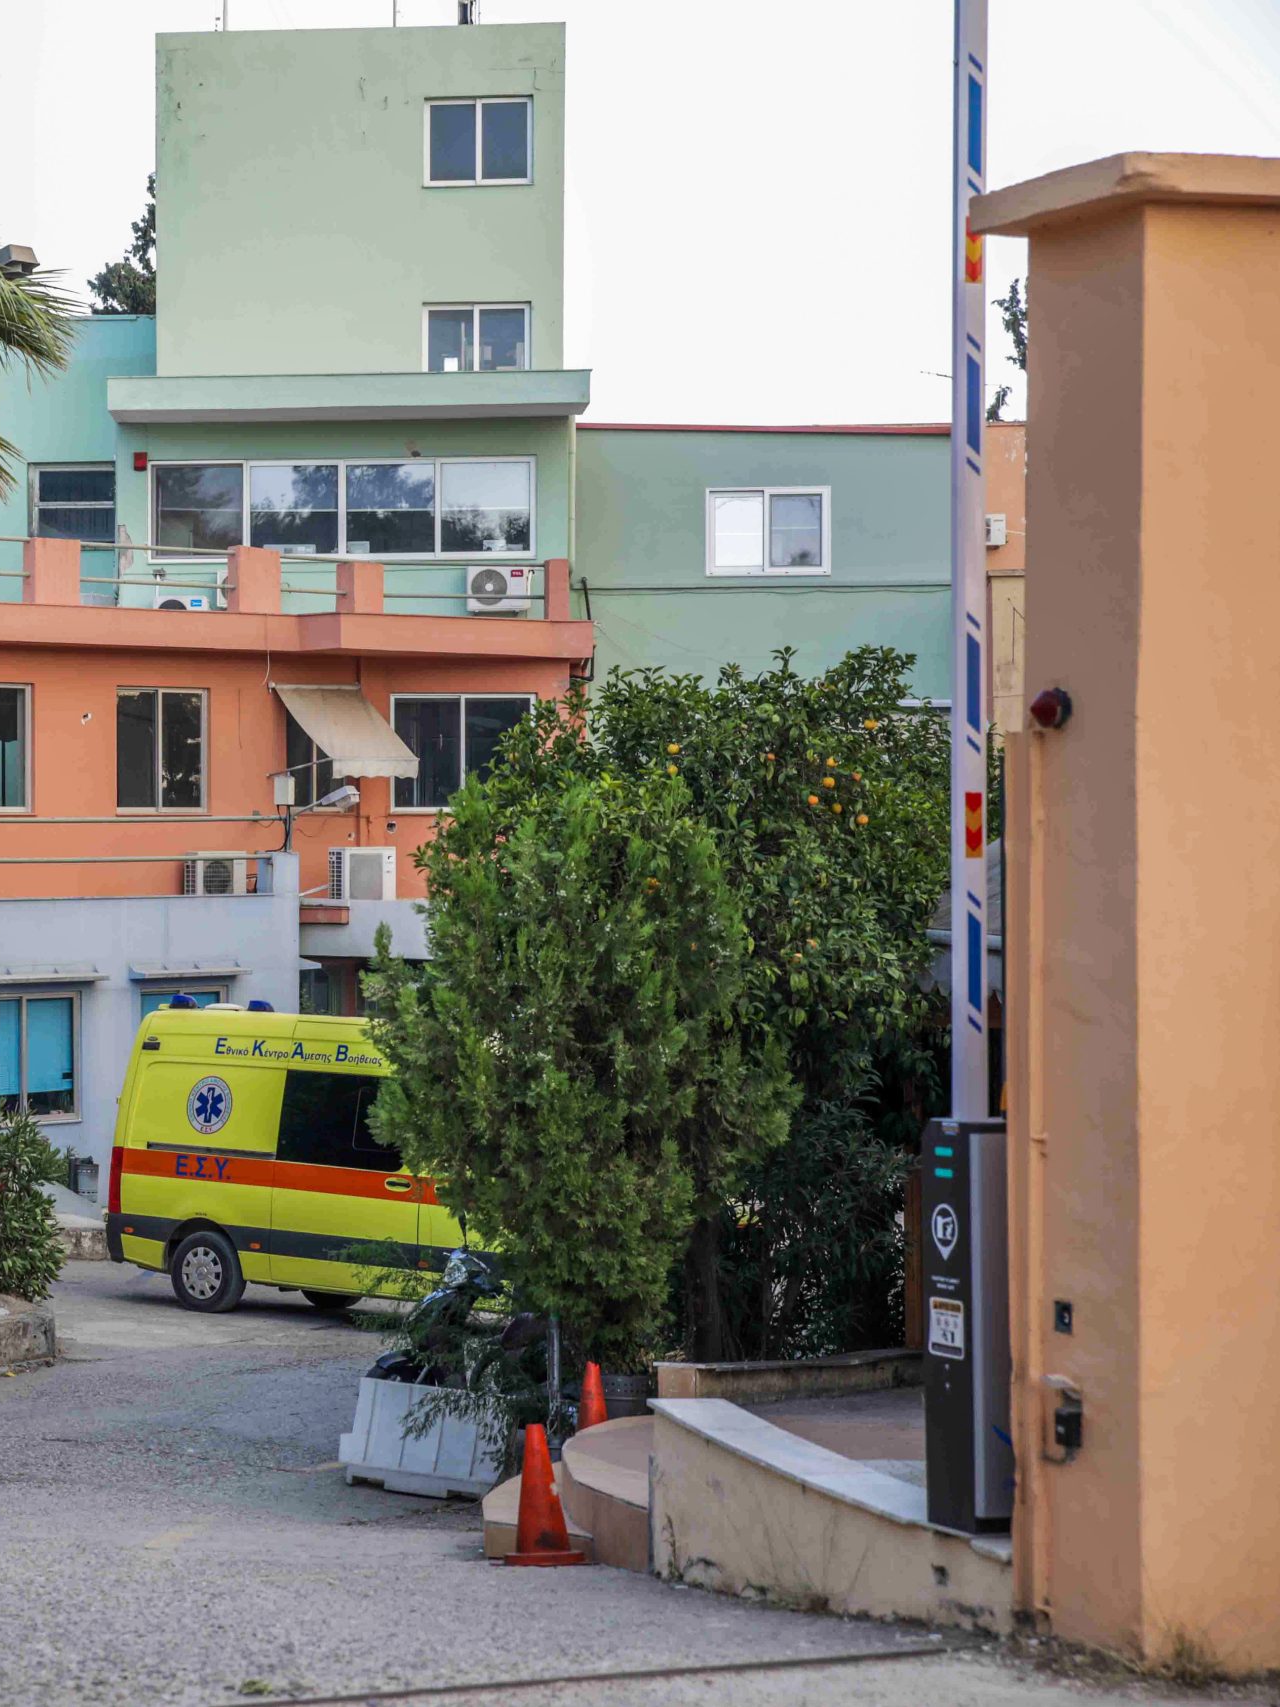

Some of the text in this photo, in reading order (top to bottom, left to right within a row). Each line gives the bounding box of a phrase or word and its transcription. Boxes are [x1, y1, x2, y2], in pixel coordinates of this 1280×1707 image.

[215, 1037, 383, 1067] Εθνικό Κέντρο Άμεσης Βοήθειας
[175, 1154, 232, 1180] Ε.Σ.Υ.
